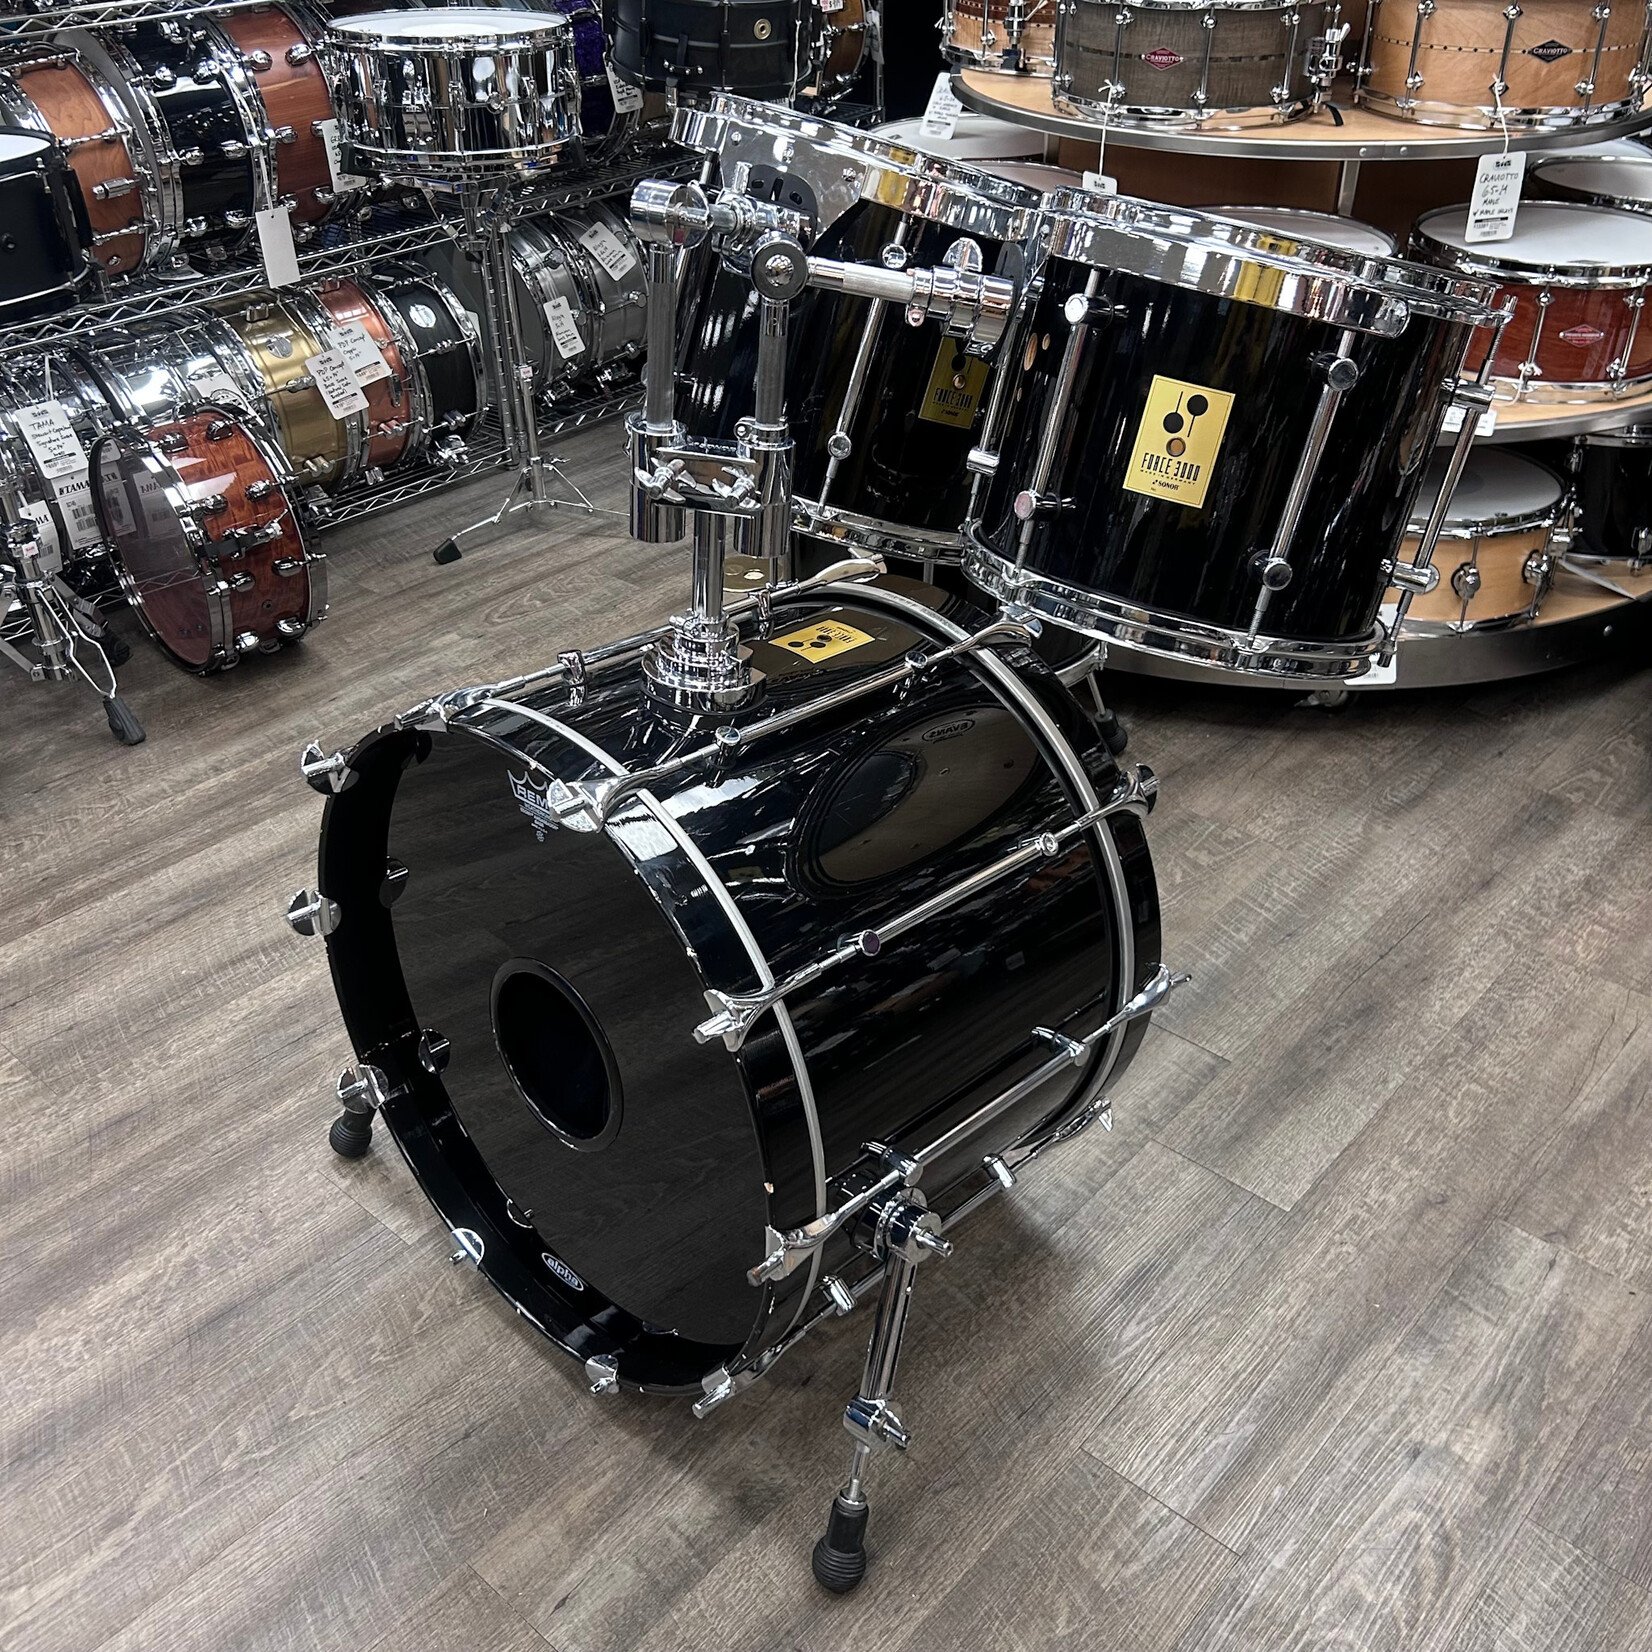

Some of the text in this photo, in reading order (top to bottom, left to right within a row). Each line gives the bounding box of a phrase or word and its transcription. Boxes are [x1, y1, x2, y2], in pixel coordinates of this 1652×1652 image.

[29, 419, 55, 430] TAMA
[1141, 452, 1201, 482] FORCE 3000
[1158, 480, 1180, 491] SONOR
[516, 784, 549, 810] REM
[547, 1257, 579, 1287] alpha
